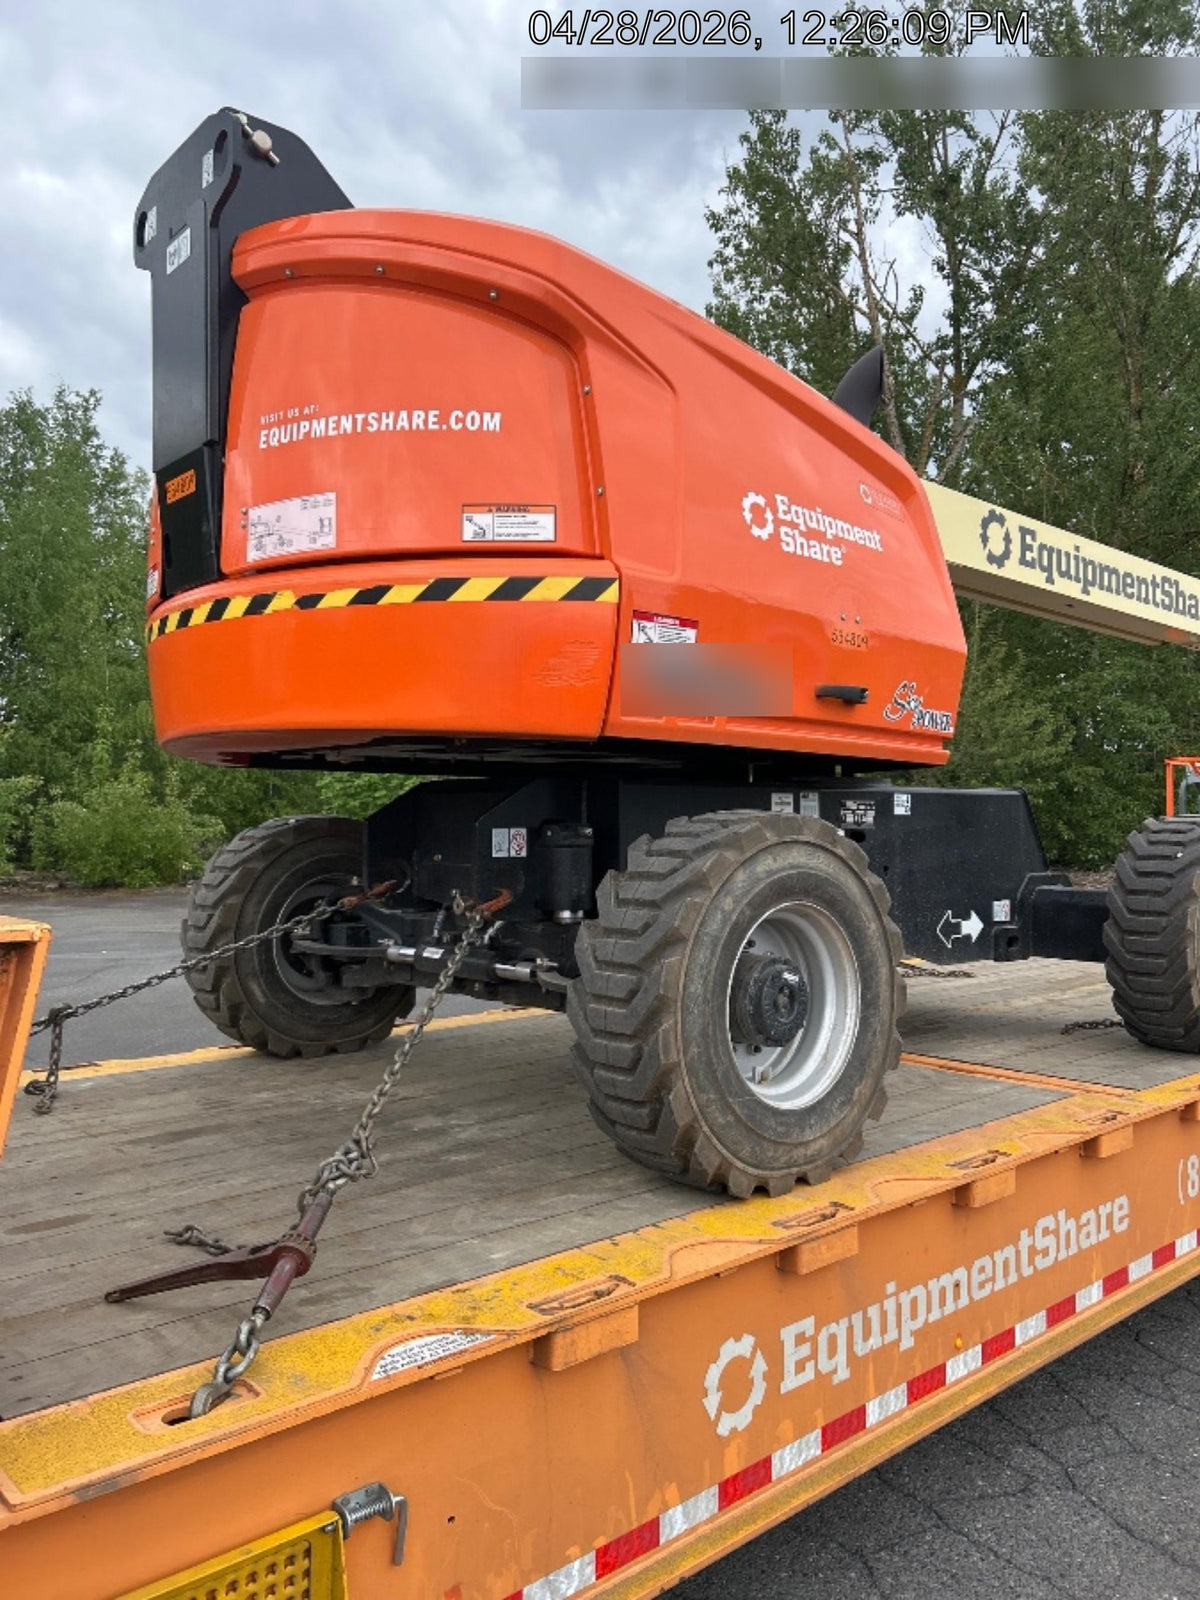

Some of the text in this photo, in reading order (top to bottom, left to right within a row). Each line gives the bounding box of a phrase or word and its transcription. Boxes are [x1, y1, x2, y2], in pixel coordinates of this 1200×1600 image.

[258, 409, 502, 449] EQUIPMENTSHARE.COM
[260, 404, 320, 425] VISIT US AT:
[774, 494, 884, 552] Equipment
[1018, 525, 1200, 620] EquipmentSha
[779, 1193, 1130, 1394] EquipmentShare
